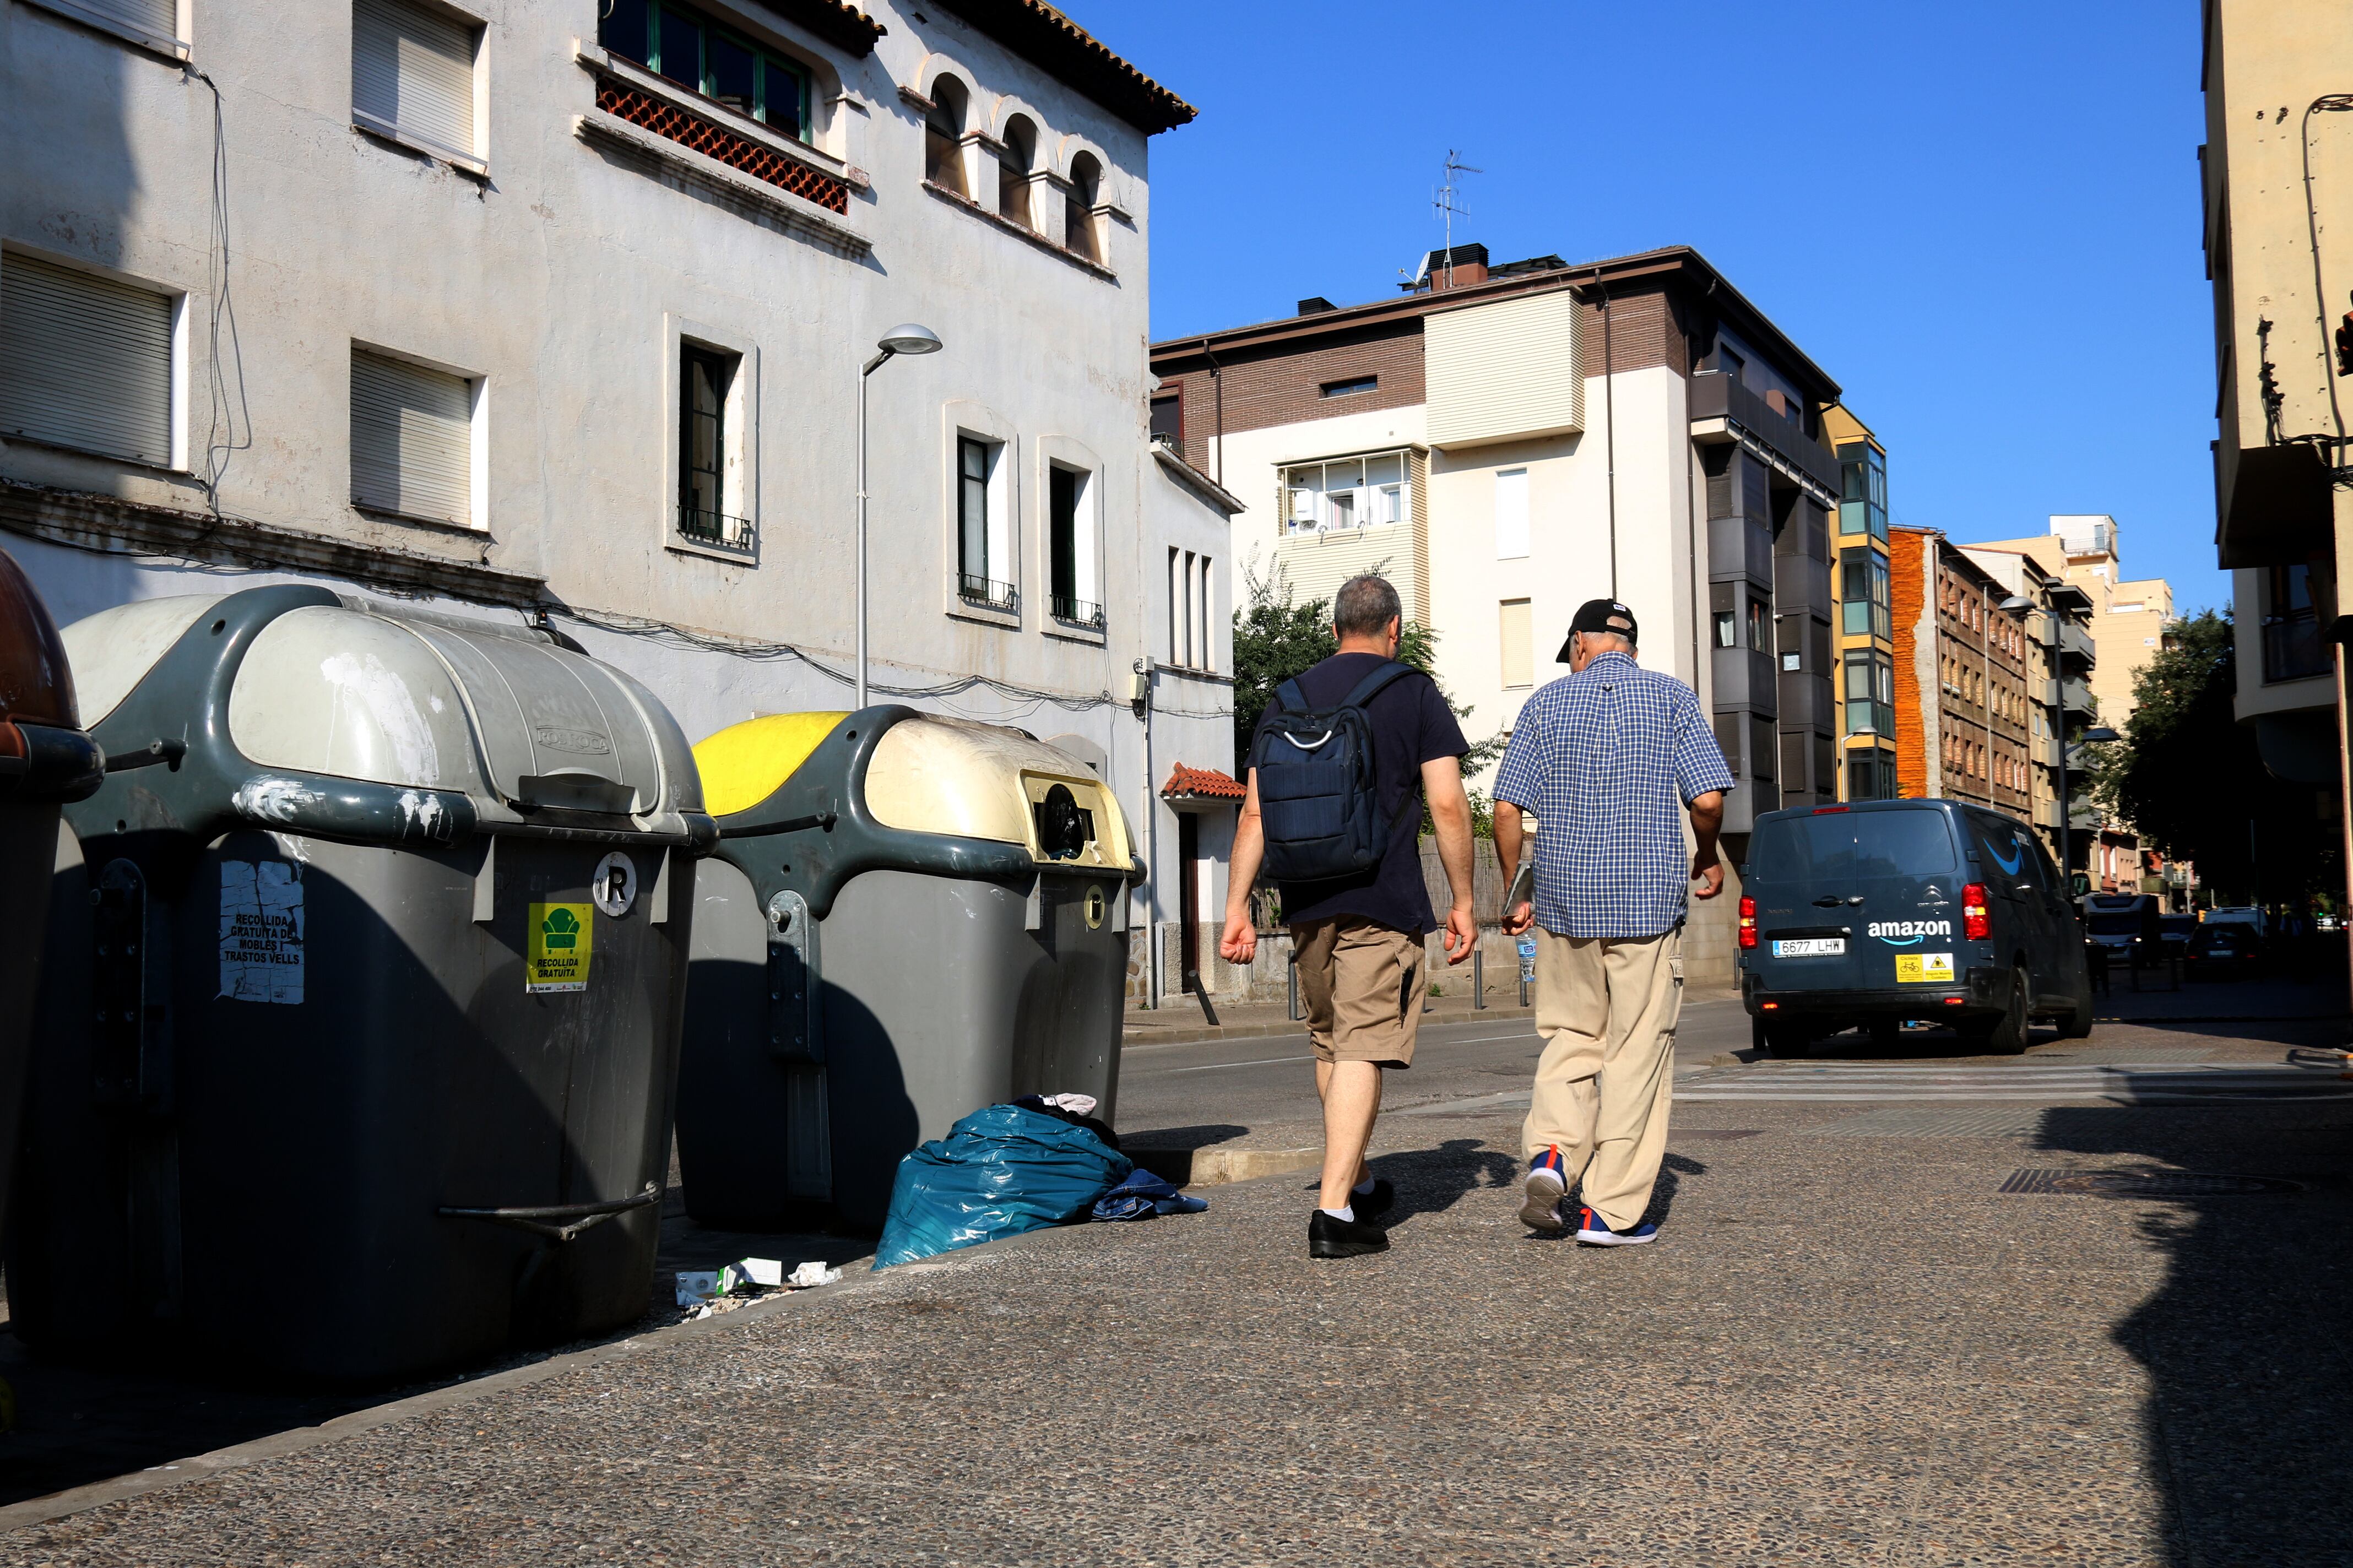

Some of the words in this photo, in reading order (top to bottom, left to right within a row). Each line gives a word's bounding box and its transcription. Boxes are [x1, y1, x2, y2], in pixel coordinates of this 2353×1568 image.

[537, 730, 567, 745] ROS
[568, 733, 609, 751] ROCA
[605, 866, 627, 902] R
[236, 914, 288, 926] RECOLLIDA
[1868, 920, 1951, 937] amazon
[240, 939, 277, 951] MOBLES
[1782, 941, 1810, 953] 6677
[1818, 940, 1840, 952] LHW
[225, 951, 266, 963] TRASTOS
[269, 953, 300, 964] VELLS
[537, 958, 578, 967] RECOLLIDA
